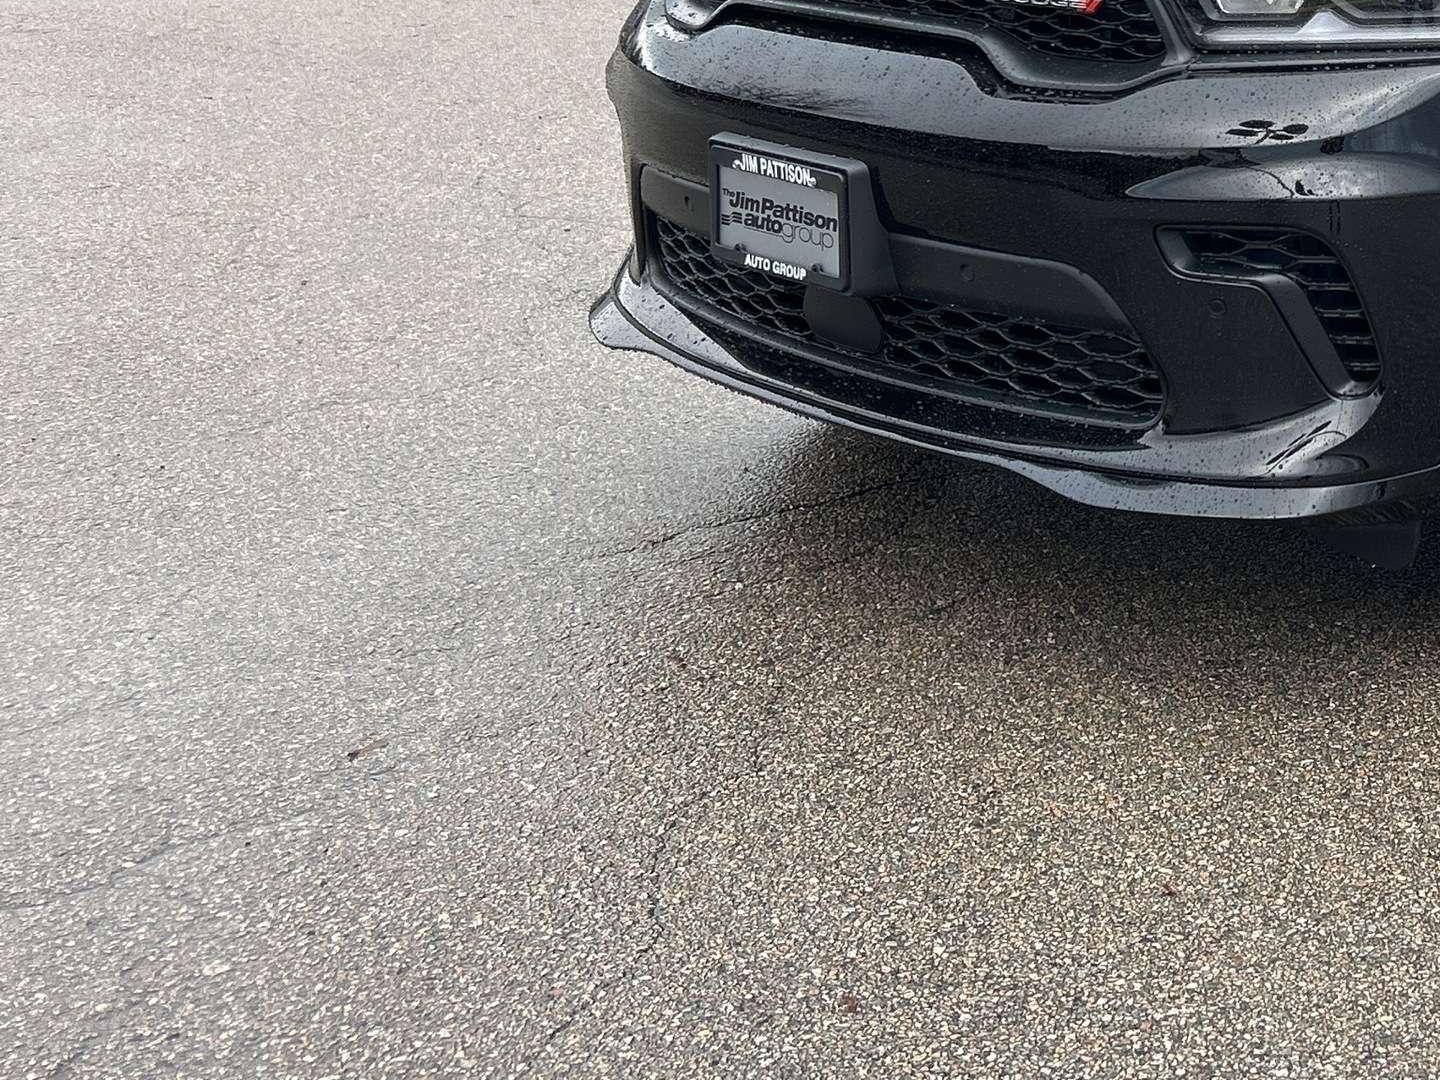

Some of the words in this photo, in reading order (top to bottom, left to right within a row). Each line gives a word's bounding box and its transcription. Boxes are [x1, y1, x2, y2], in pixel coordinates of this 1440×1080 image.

[740, 153, 759, 175] JIM
[760, 158, 811, 187] PATTISON
[722, 188, 735, 198] The
[744, 253, 771, 271] AUTO
[772, 261, 807, 280] GROUP
